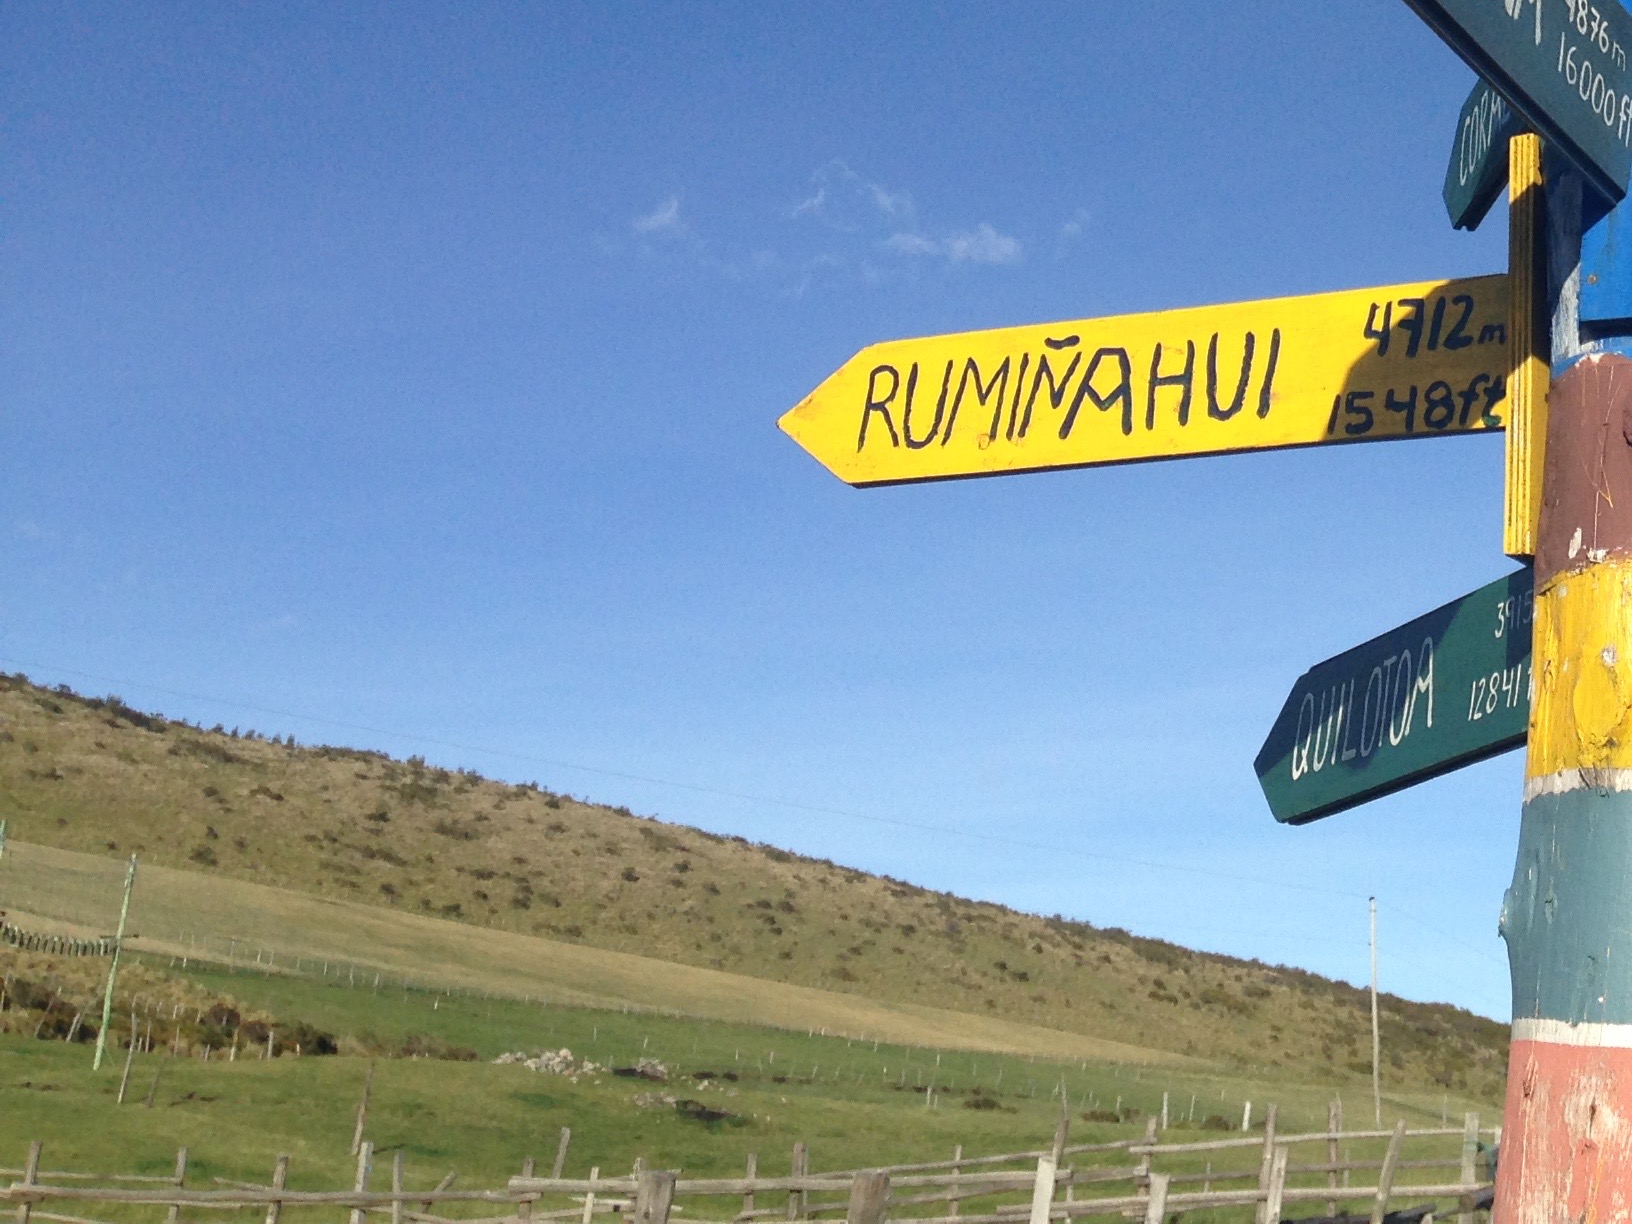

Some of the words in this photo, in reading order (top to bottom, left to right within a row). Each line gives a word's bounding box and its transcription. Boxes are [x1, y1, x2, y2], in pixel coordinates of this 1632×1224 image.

[857, 328, 1281, 453] RUMIÑAHUI
[1292, 636, 1434, 781] QUILOTOA
[1468, 663, 1521, 721] 12841
